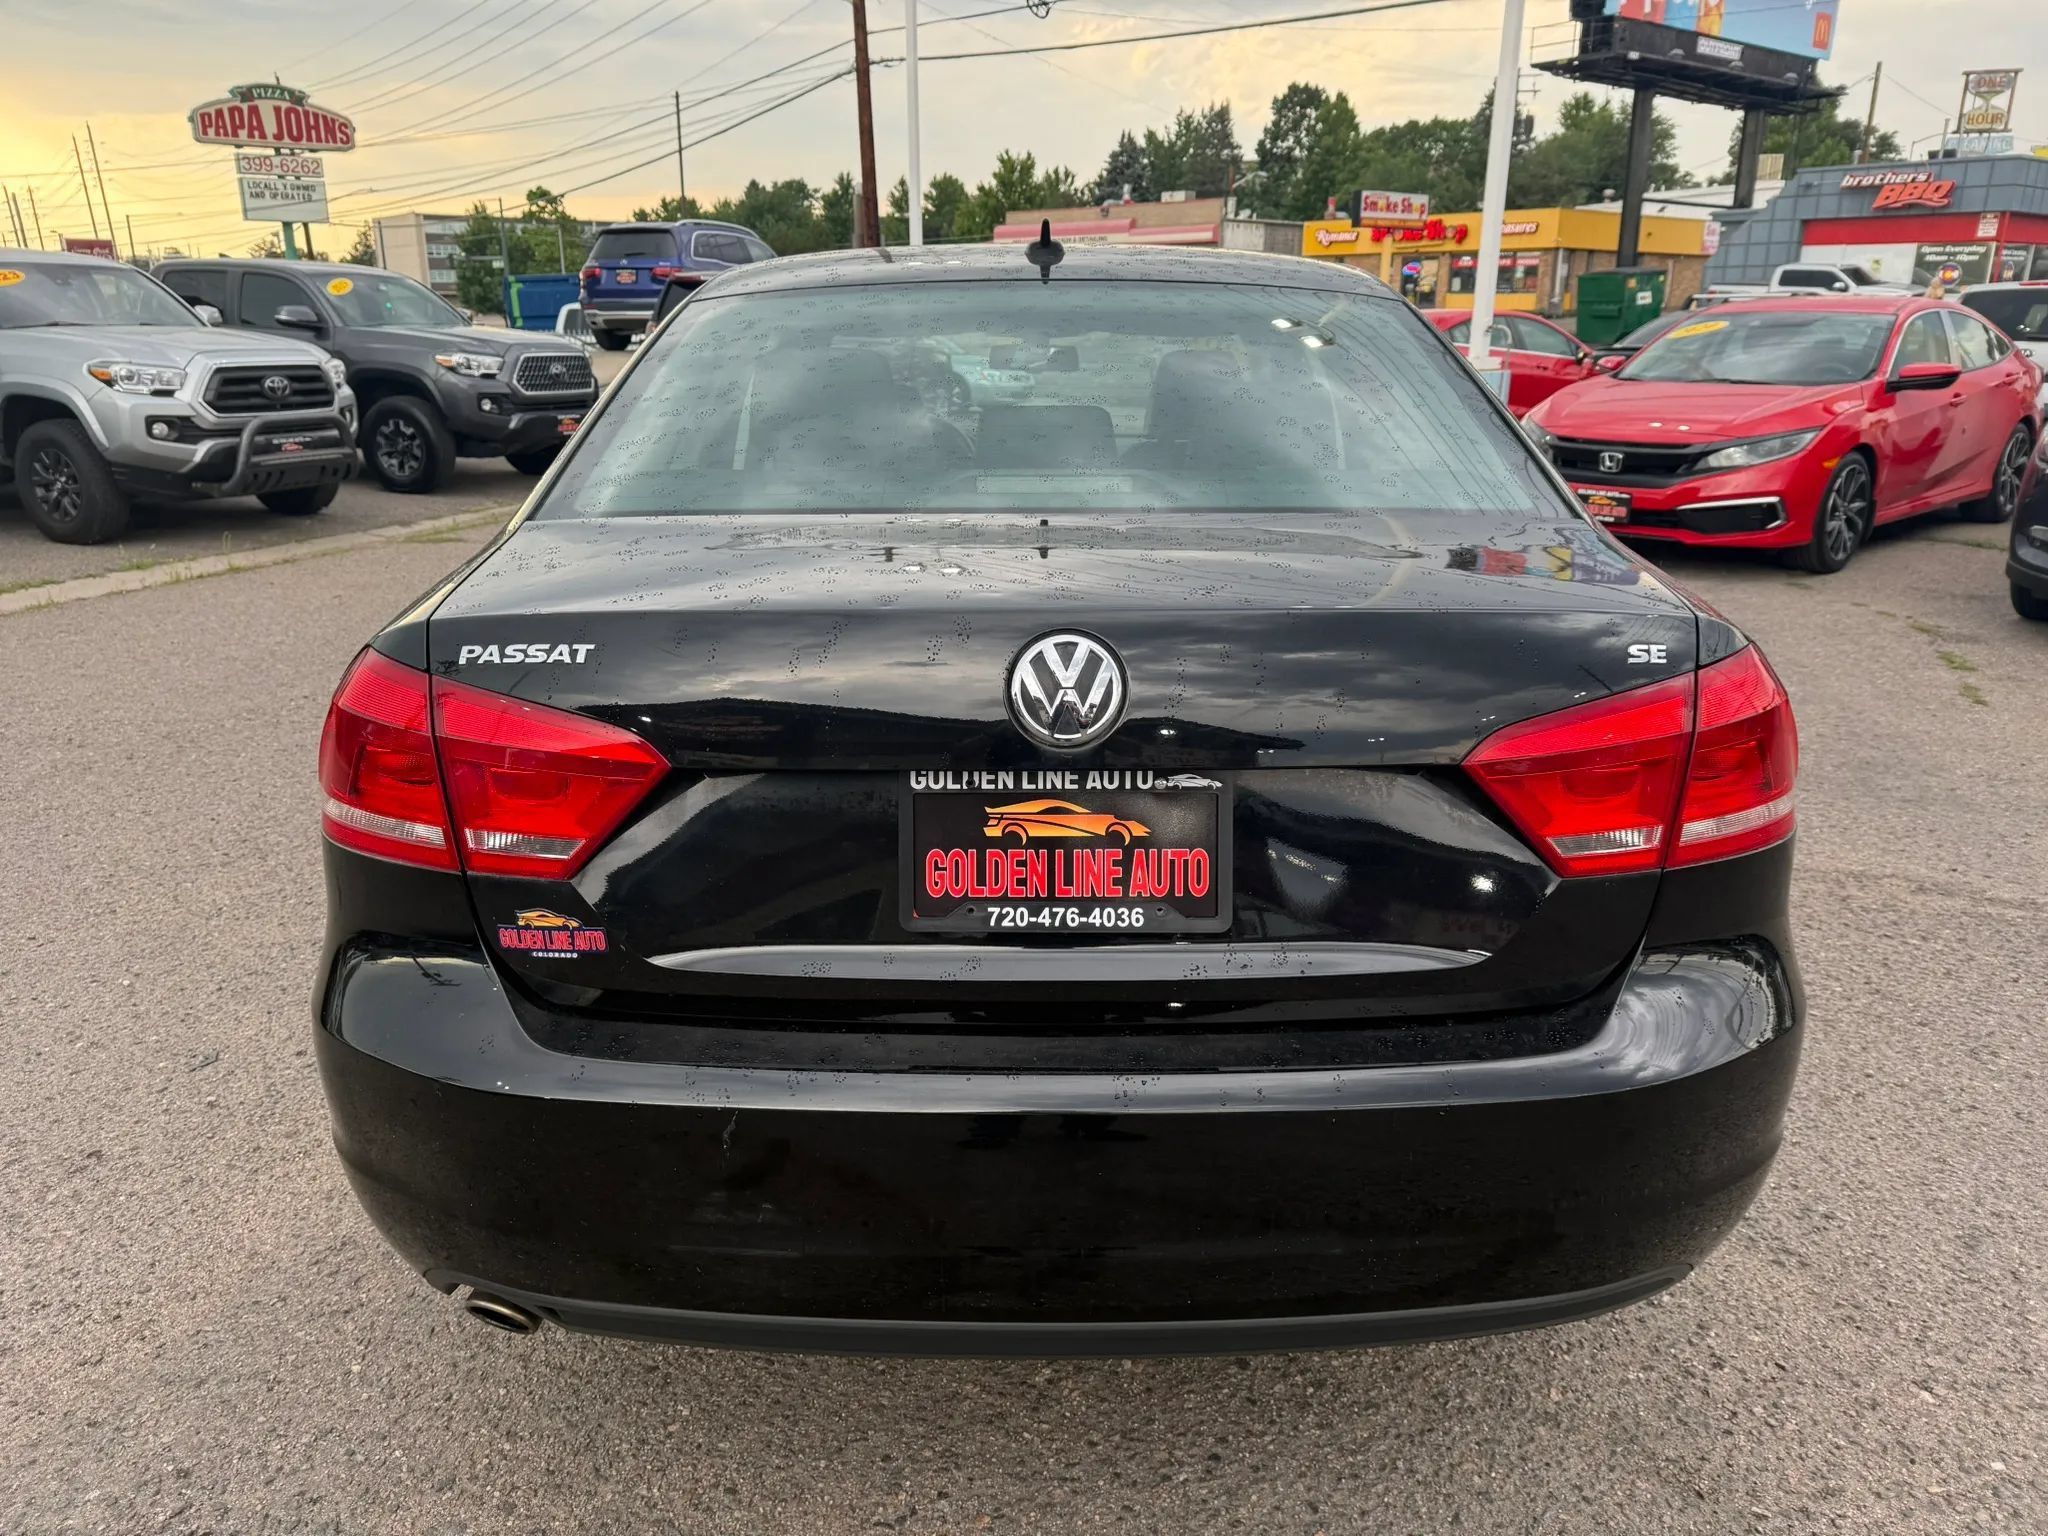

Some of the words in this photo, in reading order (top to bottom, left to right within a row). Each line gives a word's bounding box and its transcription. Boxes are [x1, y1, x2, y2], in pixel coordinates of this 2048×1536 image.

[1977, 75, 2006, 89] ONE
[252, 87, 290, 100] PIZZA
[199, 104, 268, 140] PAPA
[272, 105, 351, 146] JOHN'S
[1966, 112, 2004, 125] HOUR
[242, 156, 321, 175] 399-6262
[1840, 171, 1931, 188] brothers
[249, 191, 266, 200] AND
[269, 192, 313, 202] OPERATED
[1872, 181, 1956, 209] BBQ
[1920, 245, 1944, 254] Open
[1945, 244, 1987, 254] Everyday
[1955, 254, 1980, 262] 10pm
[458, 643, 596, 665] PASSAT
[1627, 644, 1668, 664] SE
[1021, 770, 1079, 790] LINE
[925, 848, 1048, 898] GOLDEN
[1054, 848, 1123, 898] LINE
[1128, 848, 1210, 898] AUTO
[987, 907, 1145, 927] 720-476-4036
[499, 928, 546, 949] GOLDEN
[544, 930, 573, 950] LINE
[574, 931, 607, 951] AUTO
[531, 951, 578, 959] COLORADO
